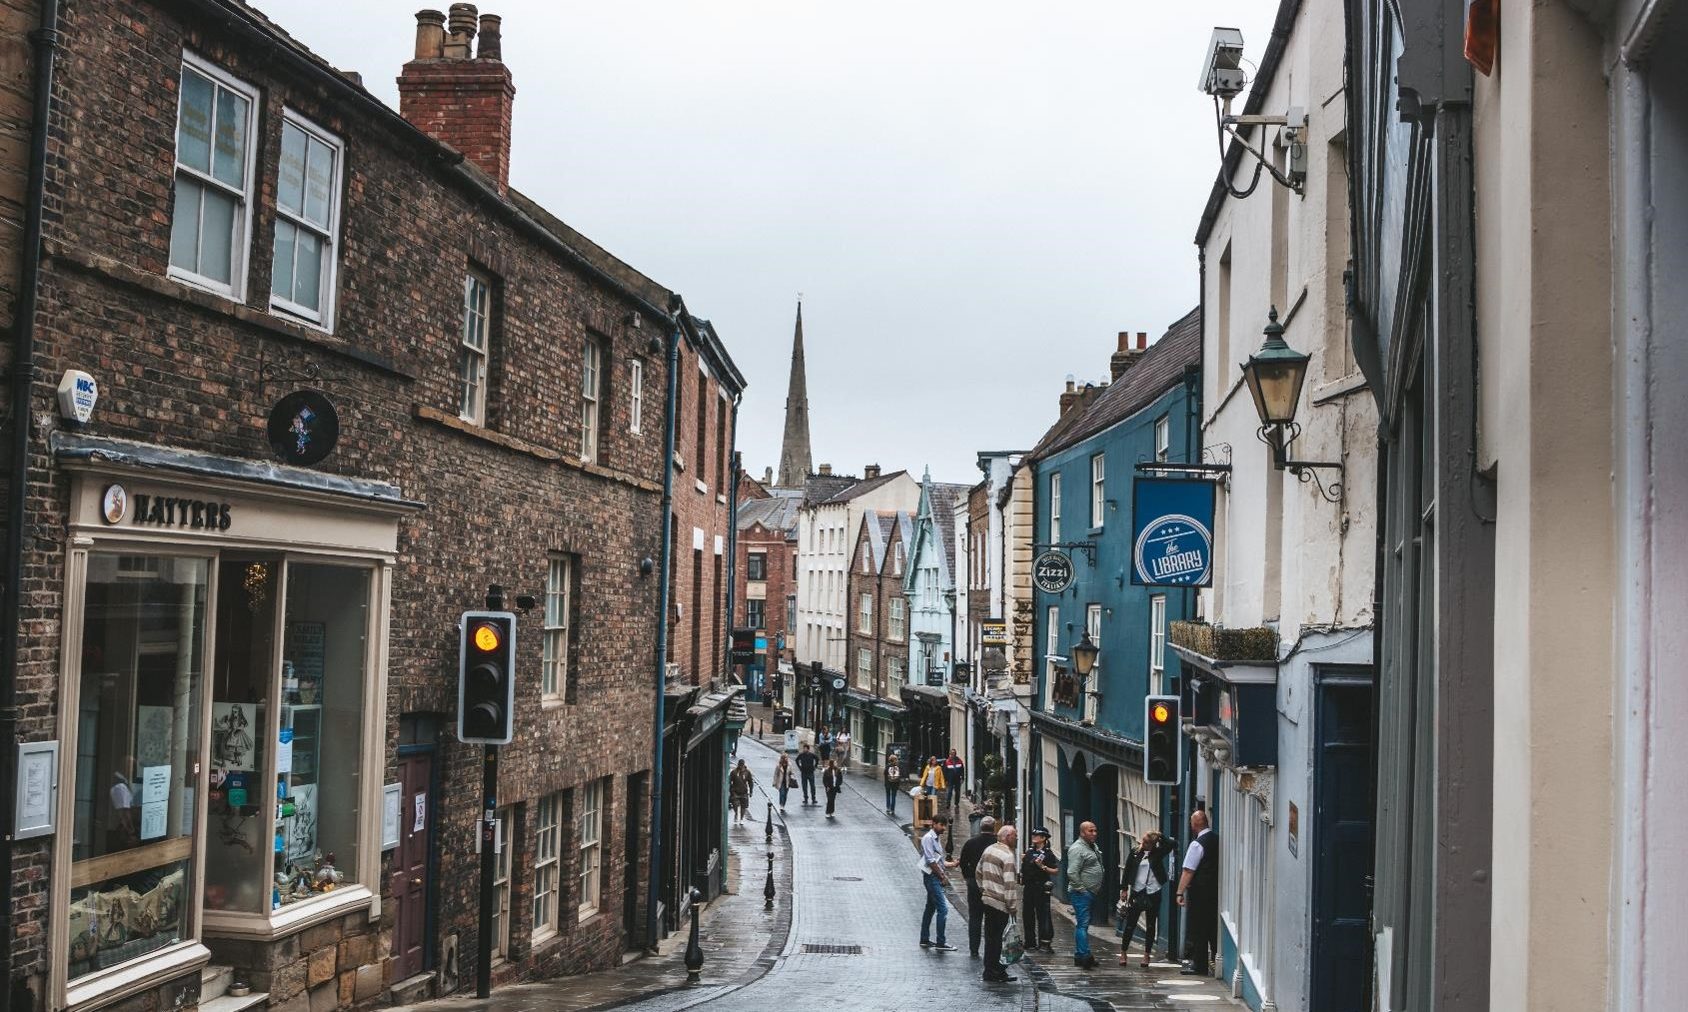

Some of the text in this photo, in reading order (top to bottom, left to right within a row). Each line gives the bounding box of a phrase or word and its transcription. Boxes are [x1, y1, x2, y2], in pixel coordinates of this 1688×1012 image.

[76, 378, 94, 394] NBC
[132, 494, 232, 530] HATTERS
[1164, 538, 1180, 554] the
[1152, 549, 1203, 577] LIBRARY
[1038, 566, 1068, 578] Zizzi
[1040, 580, 1065, 590] ITALIAN
